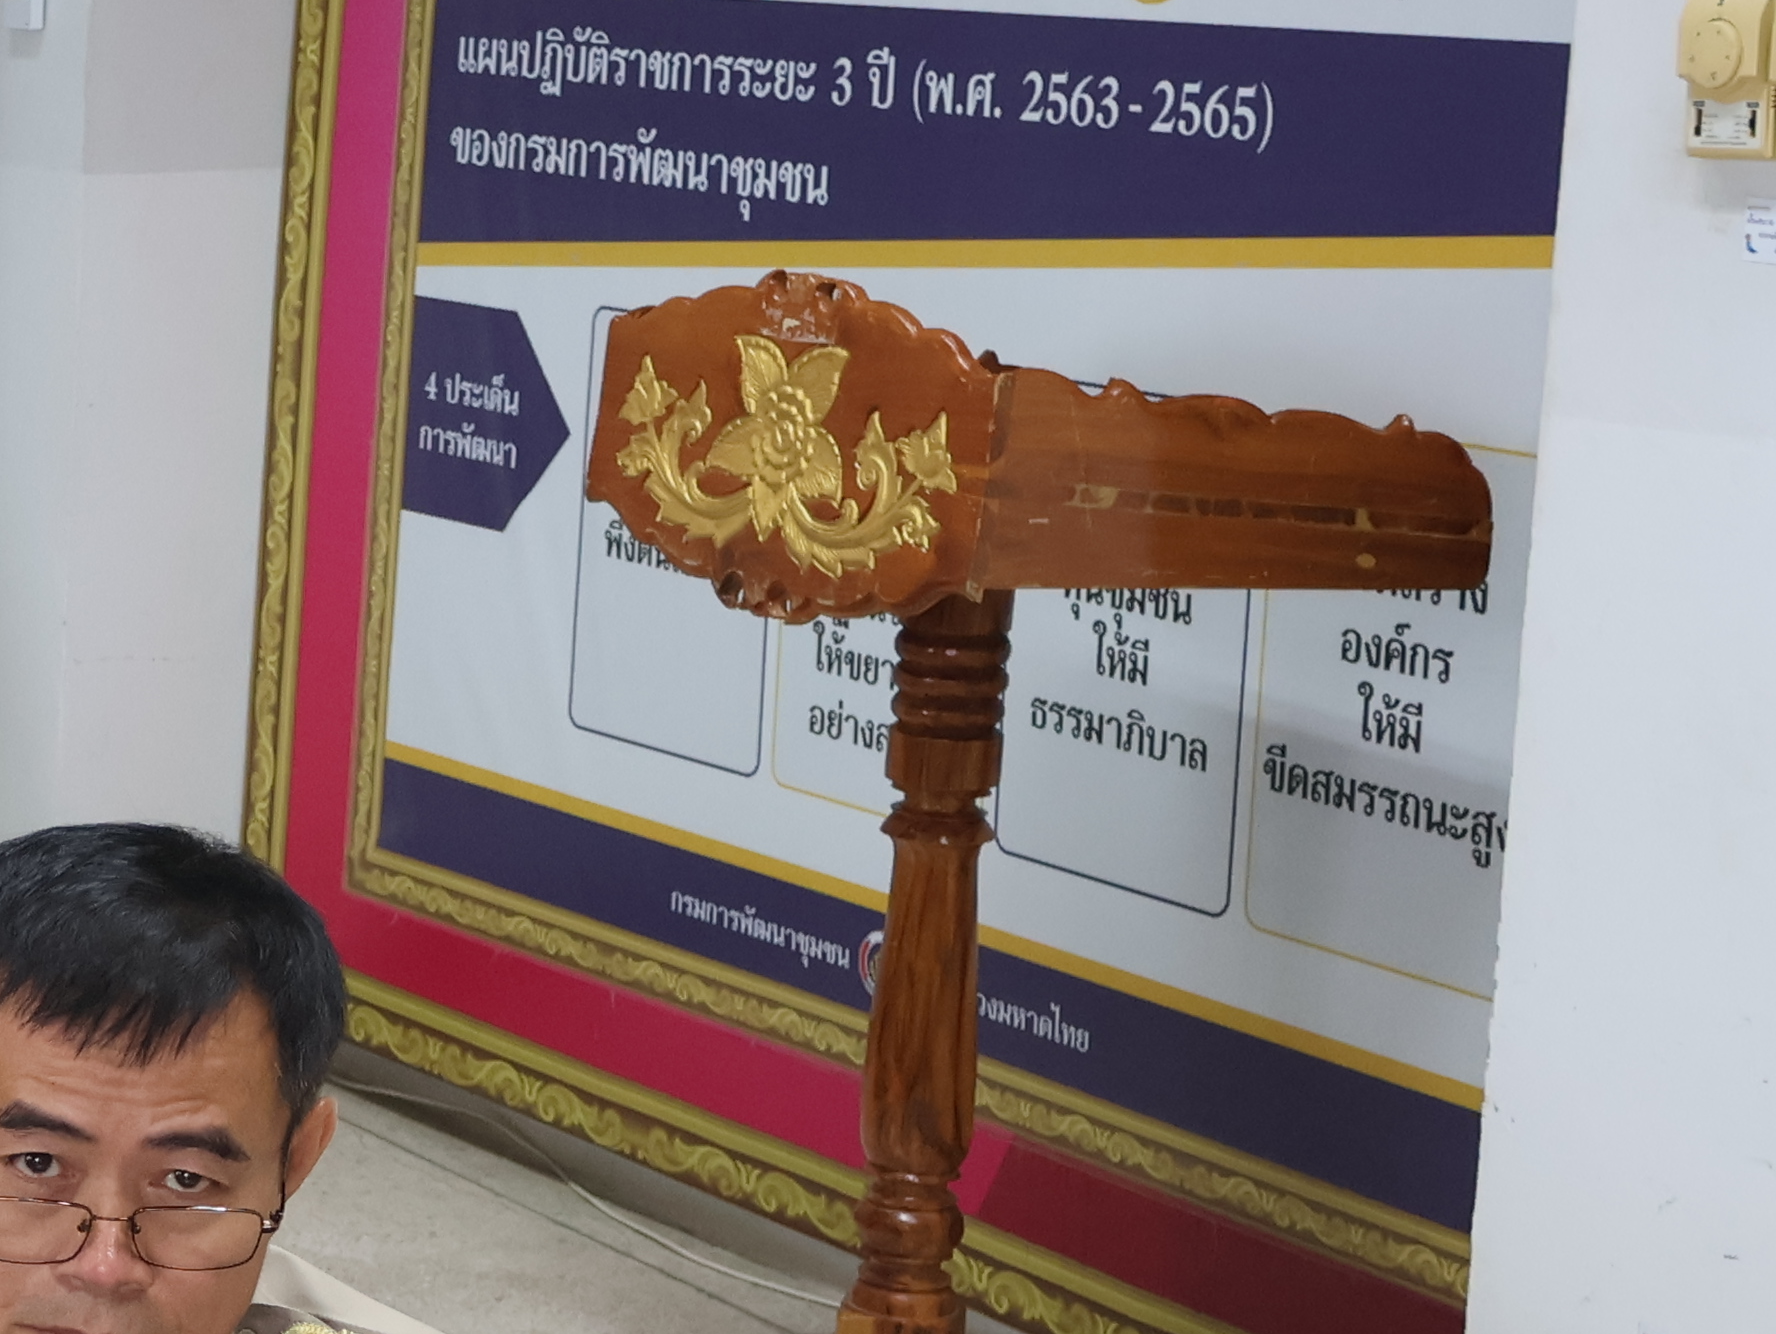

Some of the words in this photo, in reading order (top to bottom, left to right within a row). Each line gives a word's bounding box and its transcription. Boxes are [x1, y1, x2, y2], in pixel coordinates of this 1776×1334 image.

[458, 24, 817, 103] แผนปฏิบัติราชการระยะ
[830, 56, 853, 107] 3
[868, 49, 896, 111] ปี
[912, 58, 1003, 126] (พ.ศ.
[450, 127, 830, 221] ของกรมการพัฒนาชุมชน
[423, 375, 439, 402] 4
[444, 373, 520, 418] ประเด็น
[418, 422, 518, 470] การพัฒนา
[1092, 620, 1150, 687] ให้มี
[1339, 622, 1455, 685] องค์กร
[1030, 696, 1209, 774] ธรรมาภิบาล
[1357, 681, 1423, 754] ให้มี
[669, 886, 850, 969] กรมการพัฒนาชุมชน
